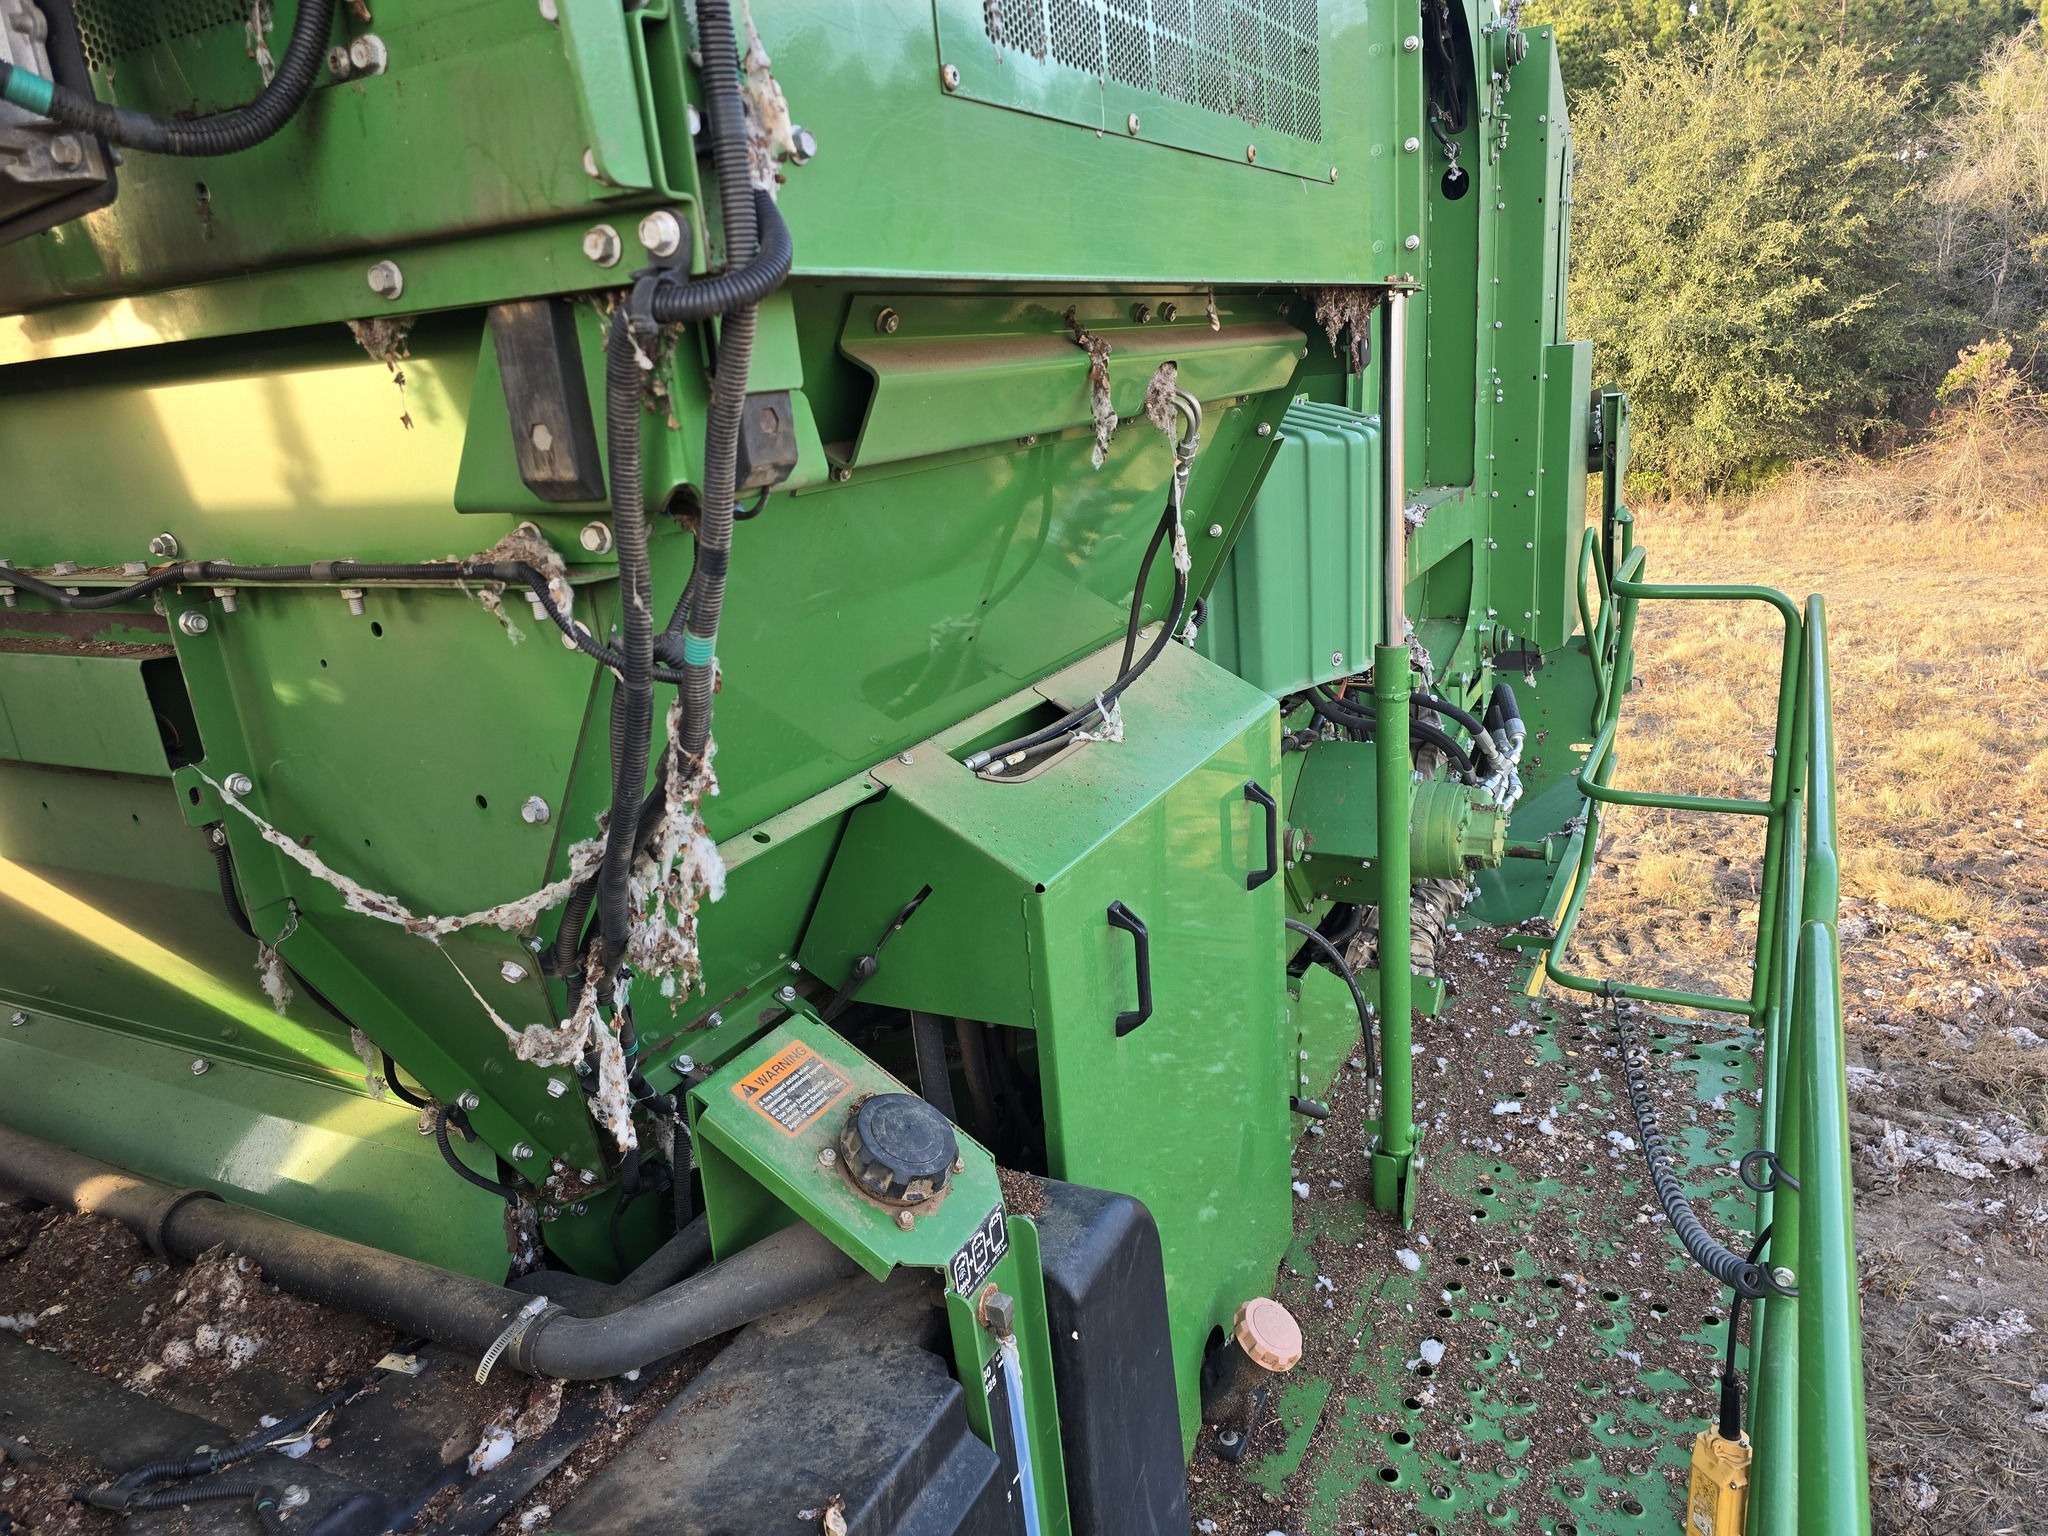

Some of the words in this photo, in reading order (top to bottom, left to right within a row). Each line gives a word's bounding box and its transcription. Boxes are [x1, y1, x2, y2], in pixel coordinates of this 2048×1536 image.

[753, 1046, 807, 1087] WARNING
[761, 1094, 773, 1102] fire
[770, 1083, 786, 1096] hazard
[799, 1100, 811, 1110] John
[810, 1090, 823, 1100] Deere
[775, 1111, 787, 1119] Use
[785, 1102, 797, 1112] John
[796, 1092, 809, 1103] Deere
[777, 1098, 791, 1108] used.
[788, 1117, 803, 1129] Agent
[1007, 1490, 1012, 1503] 5
